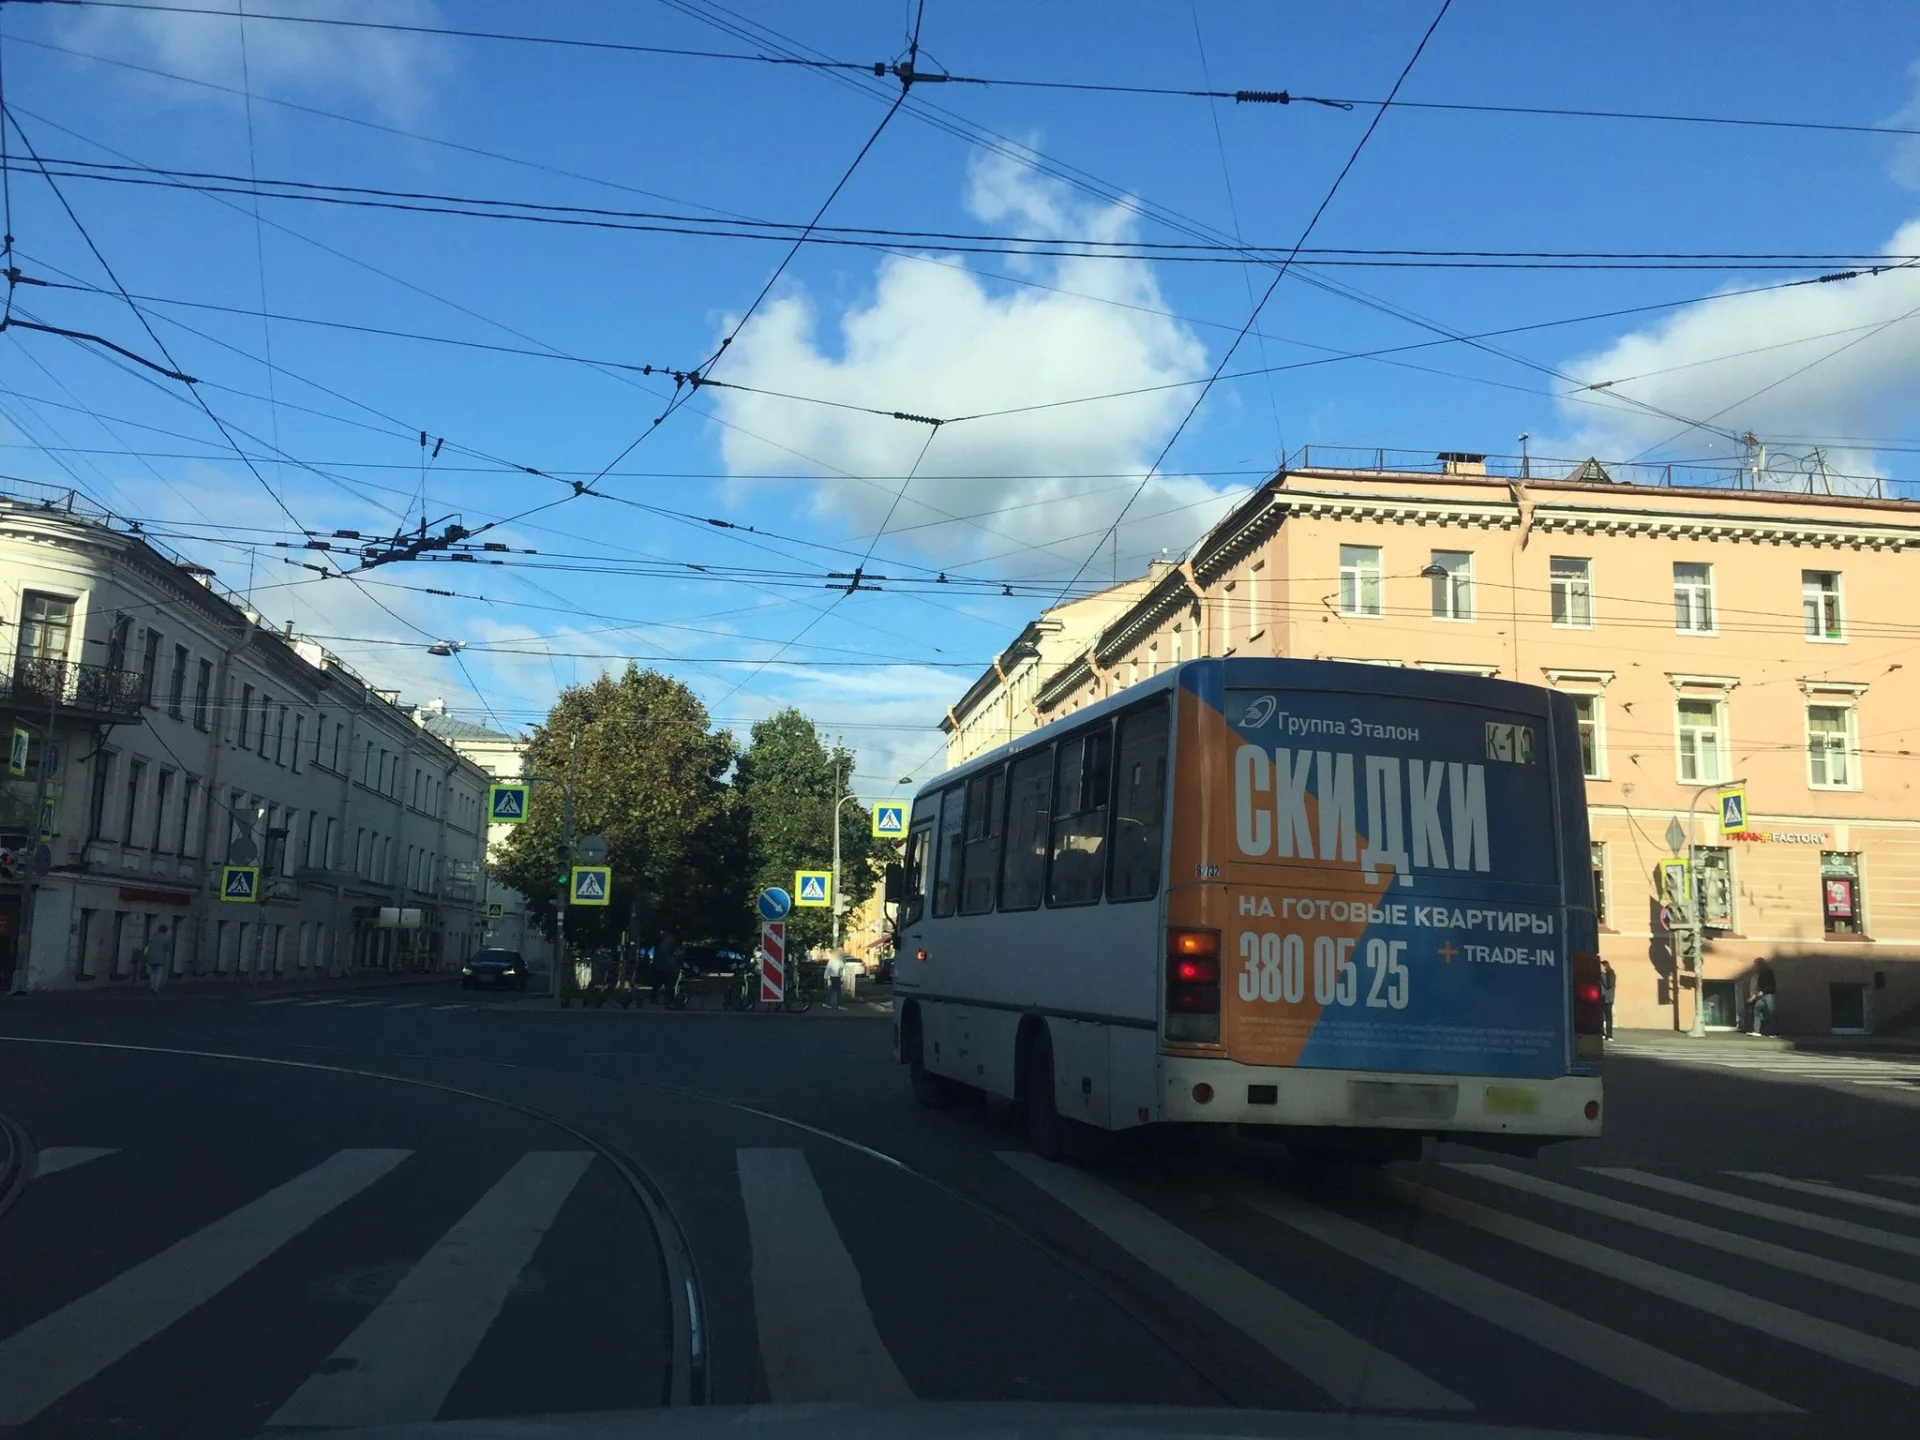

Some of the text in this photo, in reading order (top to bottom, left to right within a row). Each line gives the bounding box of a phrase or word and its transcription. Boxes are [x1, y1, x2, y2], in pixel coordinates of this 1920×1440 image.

[1278, 712, 1420, 742] Группа Эталон
[1235, 744, 1490, 887] СКИДКИ
[1239, 895, 1554, 935] НА ГОТОВЫЕ КВАРТИРЫ
[1238, 931, 1409, 1009] 380 05 25
[1463, 944, 1555, 967] TRADE-IN
